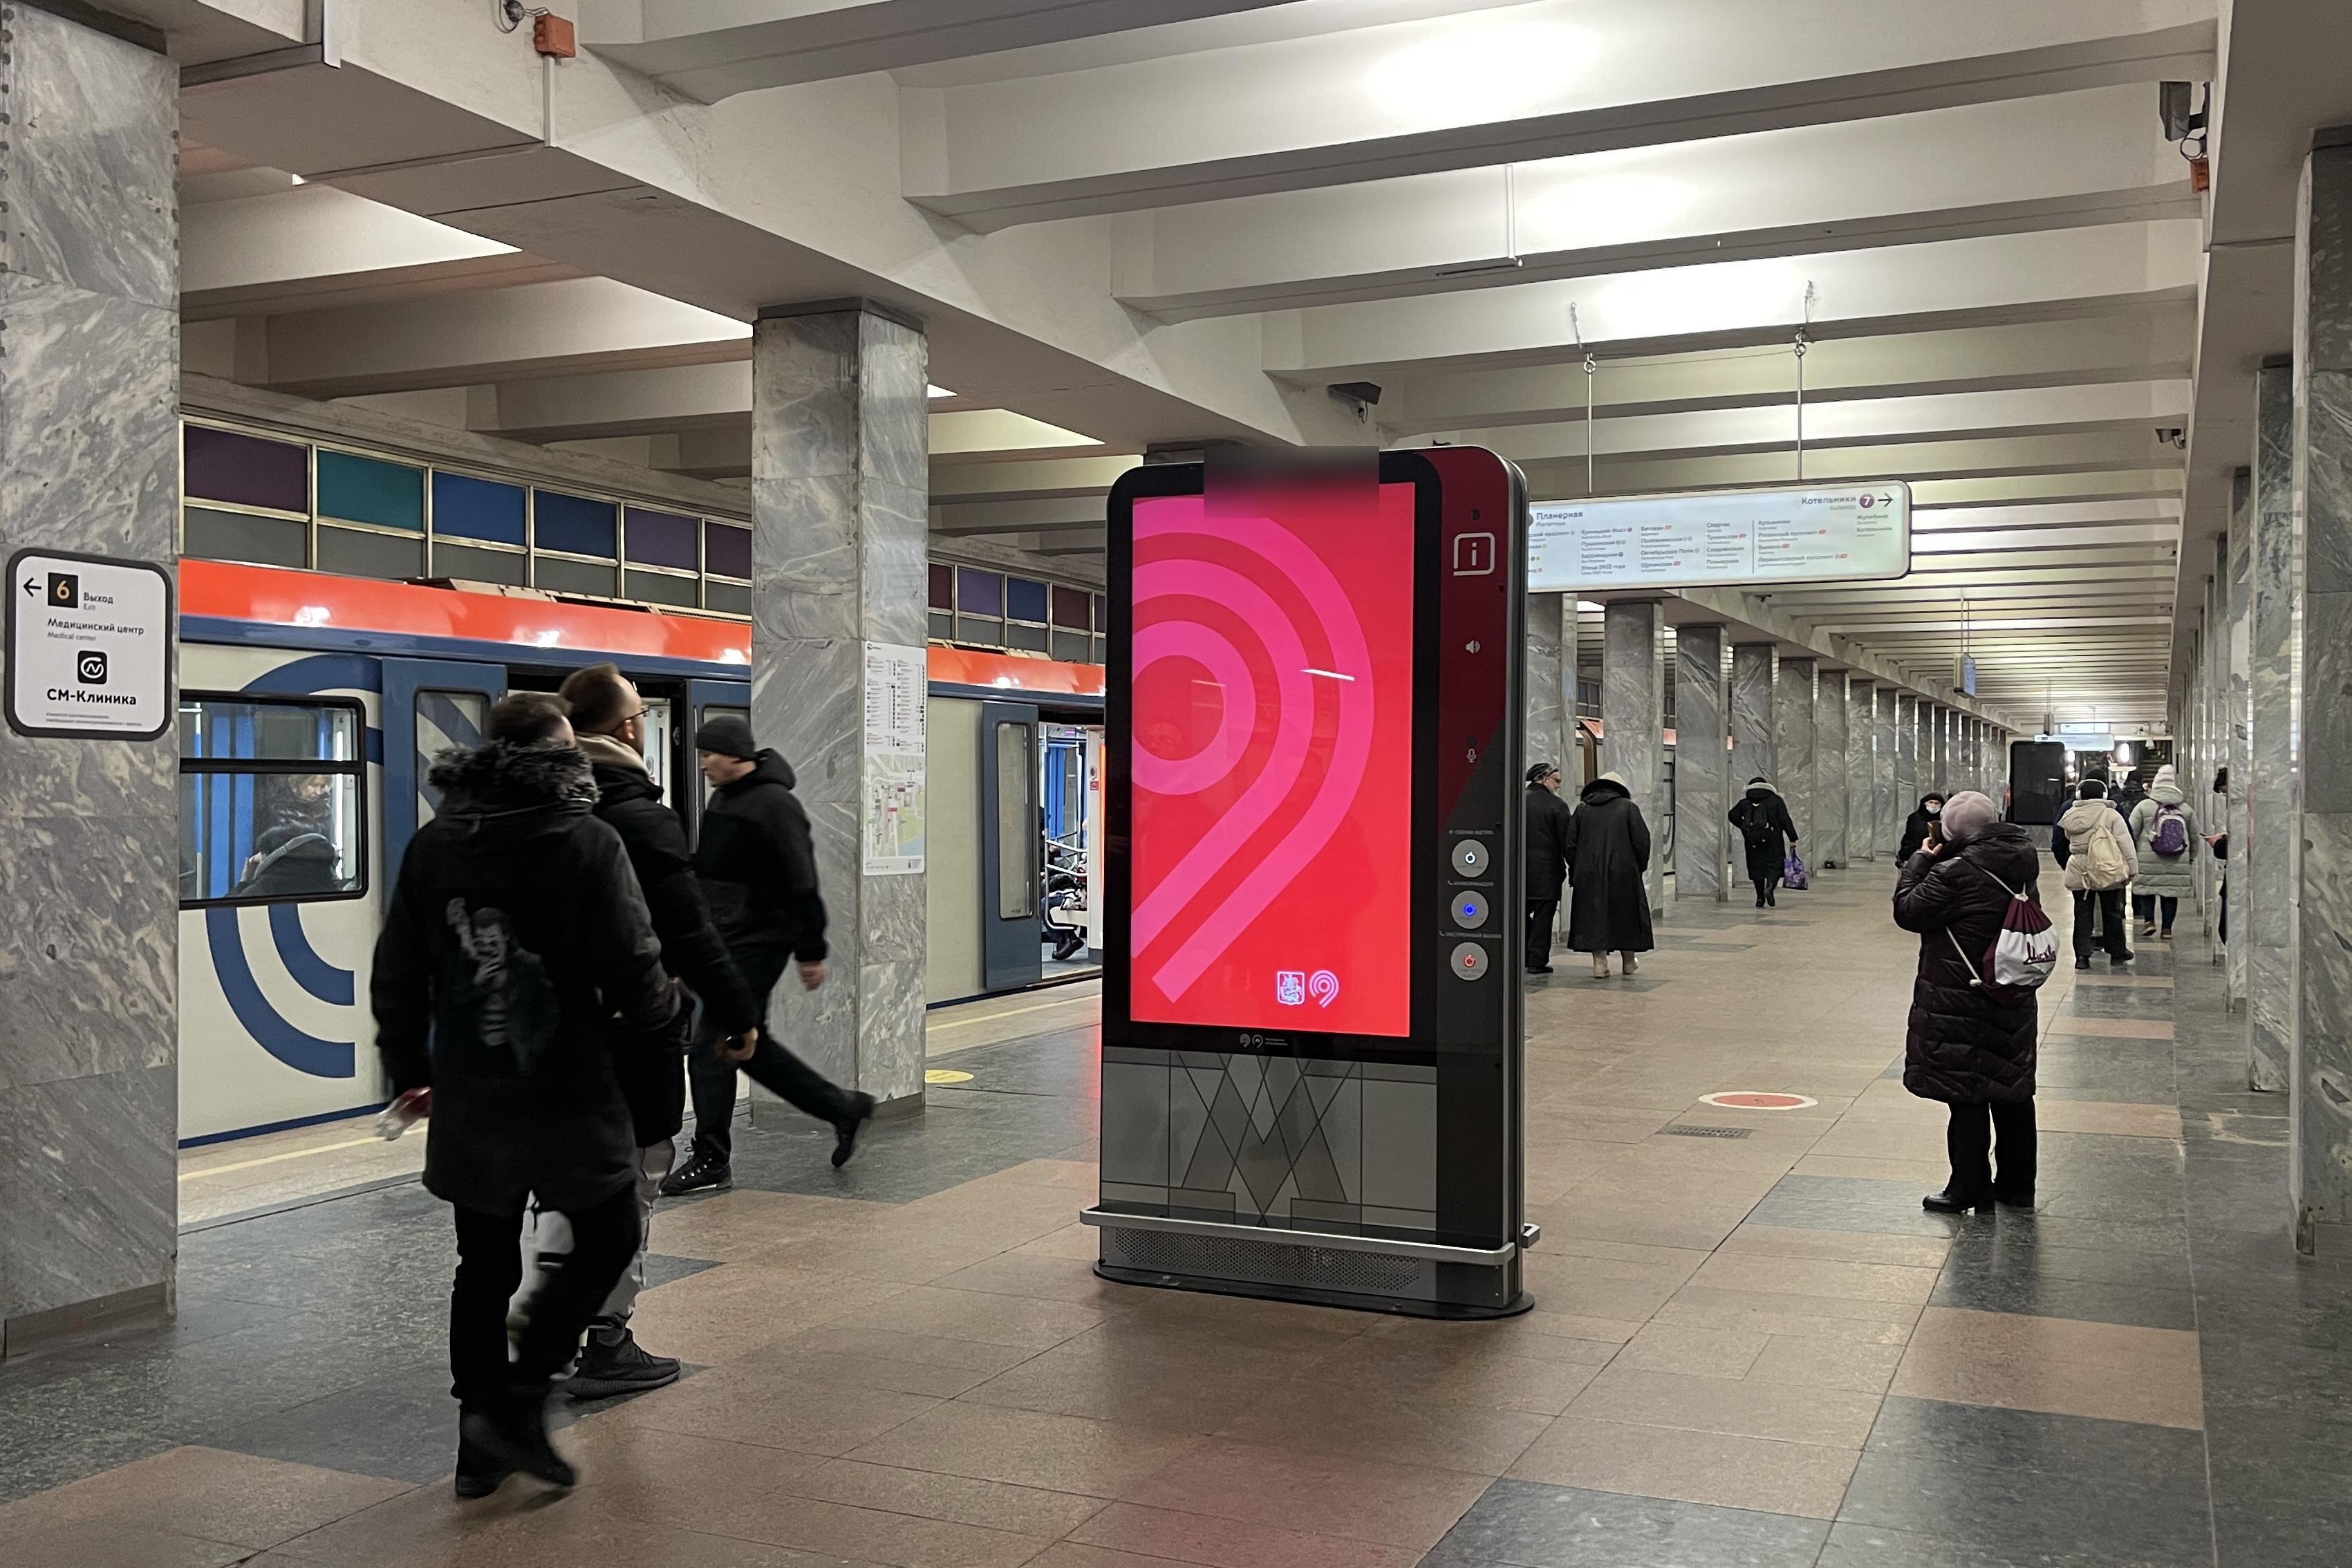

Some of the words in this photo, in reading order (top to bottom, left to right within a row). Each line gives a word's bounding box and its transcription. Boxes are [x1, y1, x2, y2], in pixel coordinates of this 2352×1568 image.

[1801, 496, 1856, 505] Котельники
[1863, 497, 1871, 506] 7
[1536, 512, 1583, 520] Планерная
[57, 580, 70, 599] 6
[83, 592, 114, 605] Выход
[47, 618, 115, 632] Медицинский
[117, 626, 144, 635] центр
[46, 688, 138, 705] СМ-Клиника
